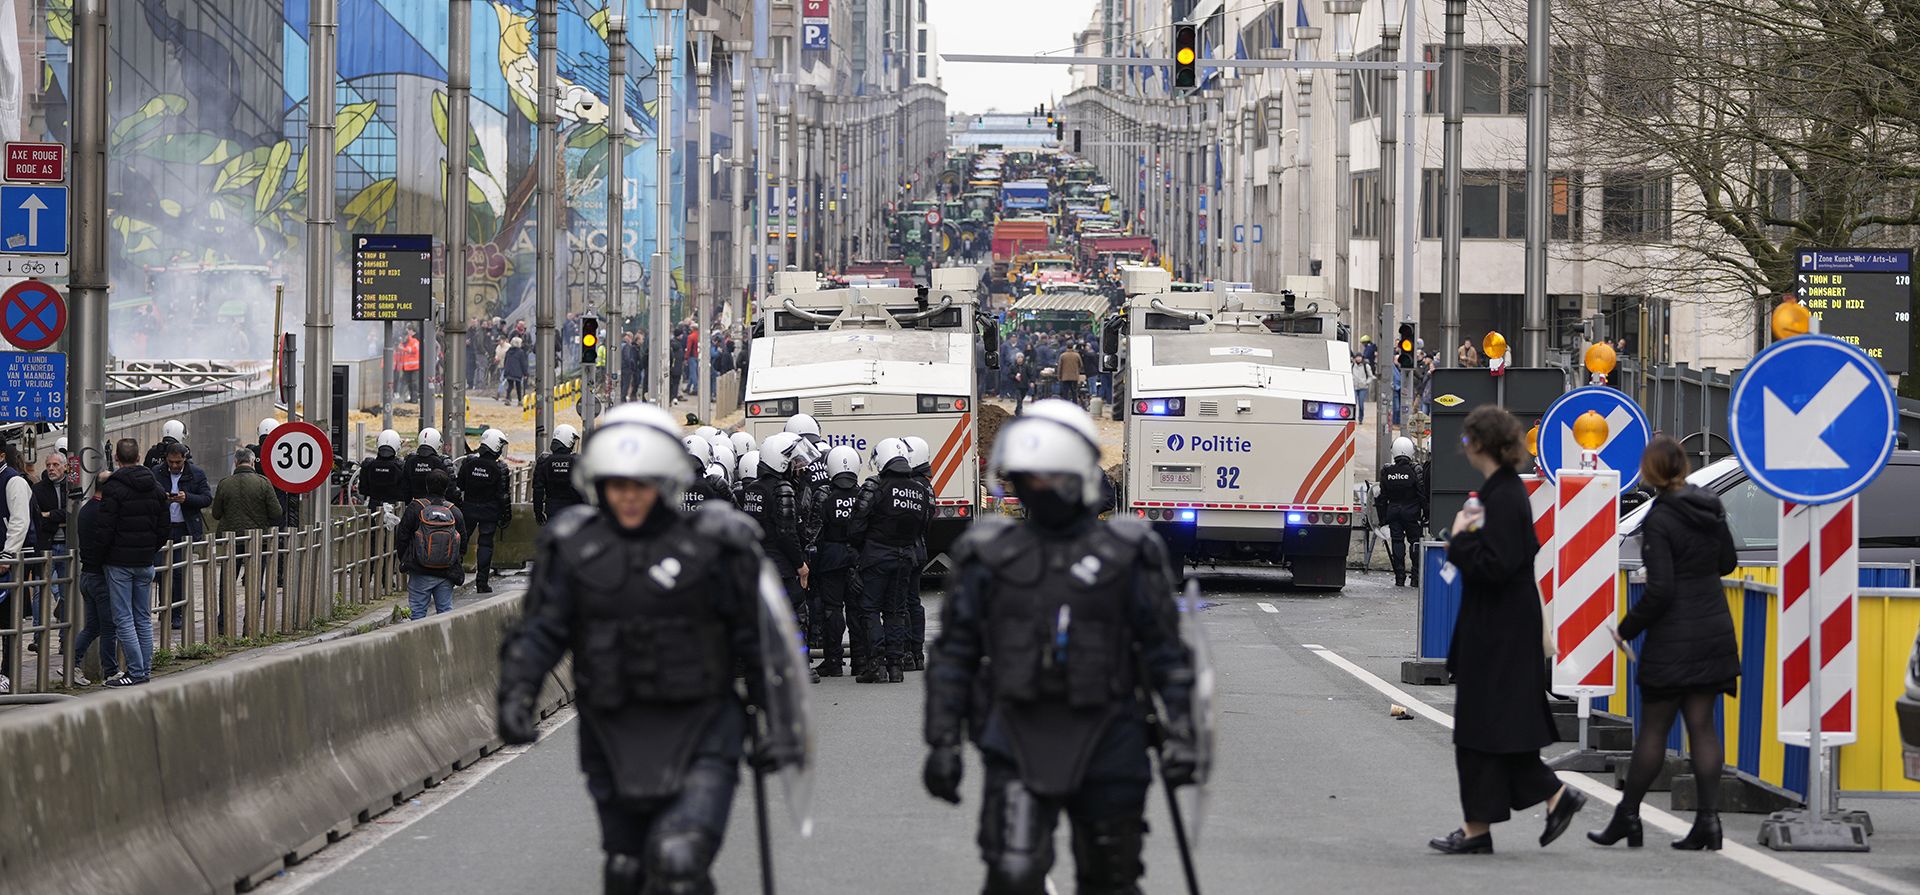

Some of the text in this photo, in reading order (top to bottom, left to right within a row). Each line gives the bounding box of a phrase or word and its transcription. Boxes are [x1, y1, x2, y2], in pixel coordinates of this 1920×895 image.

[805, 25, 820, 44] P
[11, 150, 58, 160] AXE ROUGE
[16, 164, 53, 174] RODE AS
[359, 238, 368, 249] P
[1802, 254, 1812, 268] P
[1818, 254, 1833, 263] Zone
[1834, 255, 1866, 263] Kunst-Wet
[1872, 255, 1898, 264] Arts-Loi
[1808, 274, 1911, 285] THON EU 170
[1808, 287, 1847, 296] DANSAERT
[363, 302, 376, 310] ZONE
[396, 302, 413, 310] PLACE
[1808, 299, 1865, 309] GARE DU MIDI
[1895, 312, 1910, 322] 780
[15, 355, 48, 364] DU LUNDI
[8, 363, 54, 372] AU VENDREDI
[7, 371, 56, 380] VAN MAANDAG
[9, 380, 54, 388] TOT VRIJDAG
[17, 391, 26, 402] 7
[48, 391, 61, 403] 13
[15, 406, 28, 418] 16
[48, 406, 61, 418] 18
[821, 434, 867, 451] litie
[1191, 435, 1252, 453] Politie
[277, 441, 314, 470] 30
[1216, 466, 1241, 489] 32
[681, 491, 705, 501] litie
[892, 487, 923, 500] Politie
[893, 499, 922, 511] Police
